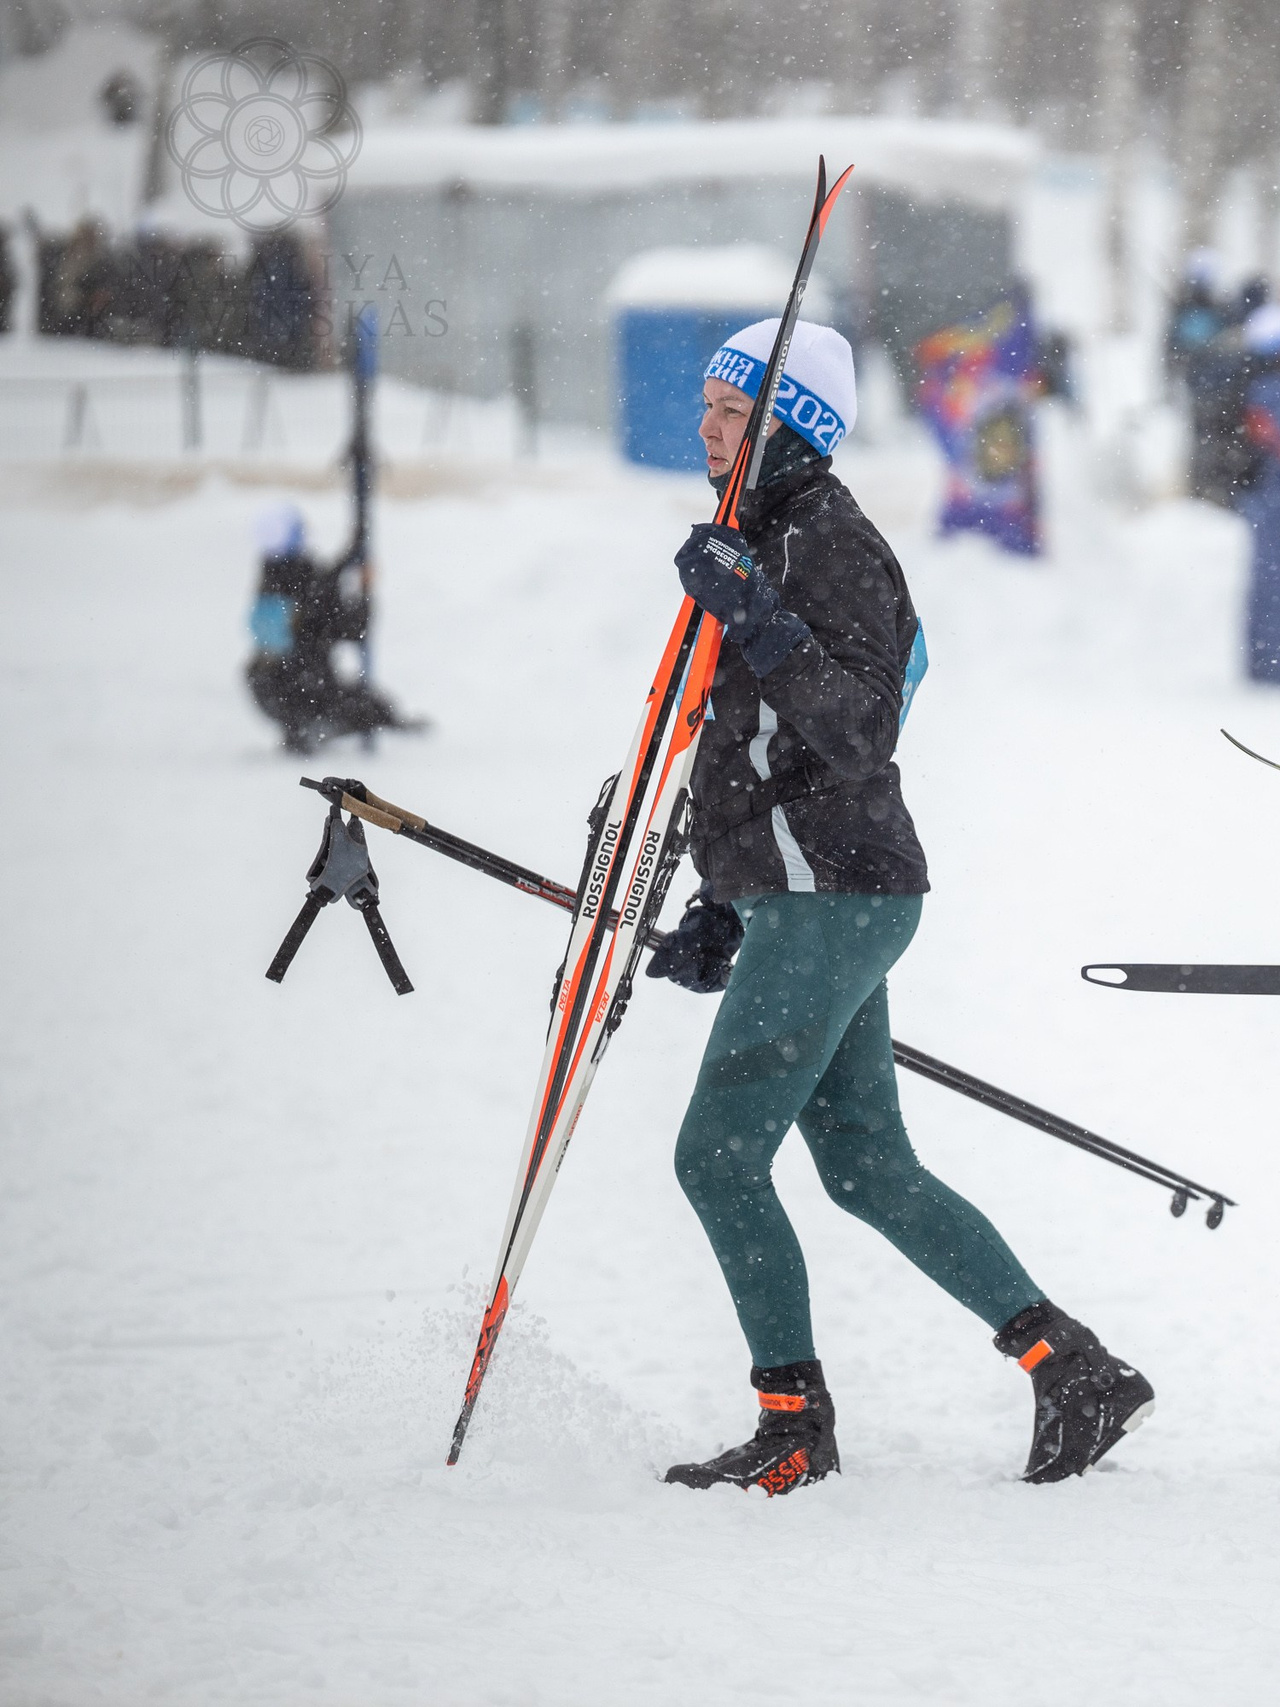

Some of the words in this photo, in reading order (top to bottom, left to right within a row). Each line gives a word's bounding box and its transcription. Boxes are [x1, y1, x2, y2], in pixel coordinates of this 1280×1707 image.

[761, 334, 793, 438] ROSSIGNOL
[581, 819, 622, 920] ROSSIGNOL
[619, 830, 661, 930] ROSSIGNOL
[557, 978, 572, 1013] DELTA
[594, 990, 610, 1024] DELTA
